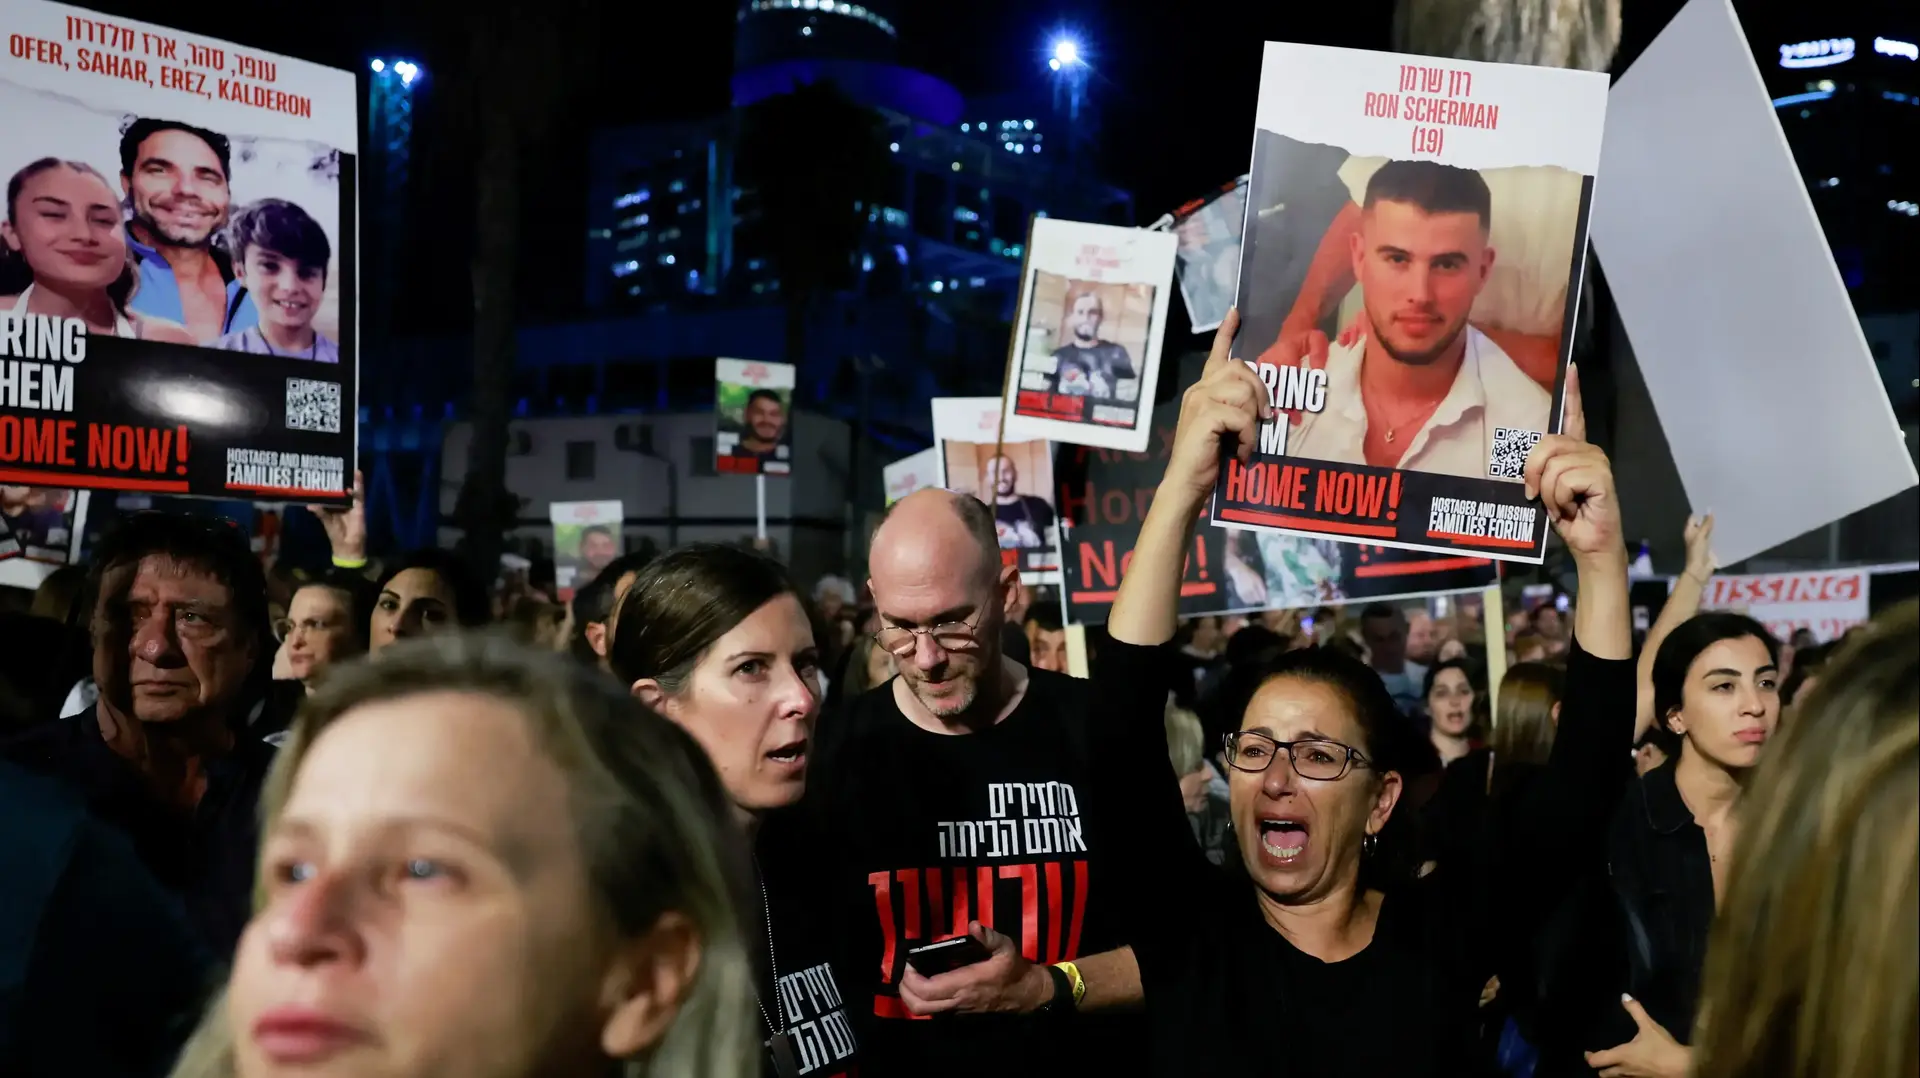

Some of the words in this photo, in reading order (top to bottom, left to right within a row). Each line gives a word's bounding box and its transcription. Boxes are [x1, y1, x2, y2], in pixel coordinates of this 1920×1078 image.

[66, 15, 135, 52] קלדרון
[143, 33, 177, 61] ארז
[9, 33, 70, 71] OFER,
[77, 48, 153, 89] SAHAR,
[160, 65, 212, 100] EREZ,
[218, 78, 312, 119] KALDERON
[1398, 64, 1443, 93] שרמן
[1448, 70, 1472, 98] רון
[1364, 91, 1399, 119] RON
[1403, 97, 1498, 130] SCHERMAN
[1411, 126, 1443, 156] (19)
[0, 310, 87, 364] RING
[0, 359, 75, 412] HEM
[1244, 361, 1327, 412] RING
[0, 415, 77, 466] OME
[88, 424, 190, 475] NOW!
[226, 447, 279, 466] HOSTAGES
[278, 452, 300, 469] AND
[301, 454, 344, 471] MISSING
[226, 463, 291, 489] FAMILIES
[294, 468, 344, 492] FORUM
[1226, 459, 1309, 511] HOME
[1314, 469, 1404, 521] NOW!
[1428, 511, 1487, 537] FAMILIES
[1488, 518, 1534, 543] FORUM
[1431, 496, 1477, 516] HOSTAGES
[1477, 502, 1496, 518] AND
[1496, 504, 1536, 523] MISSING
[1705, 575, 1860, 604] ISSING
[988, 781, 1079, 818] מחזירים
[937, 819, 1019, 858] הביתה
[1023, 816, 1088, 855] אותם
